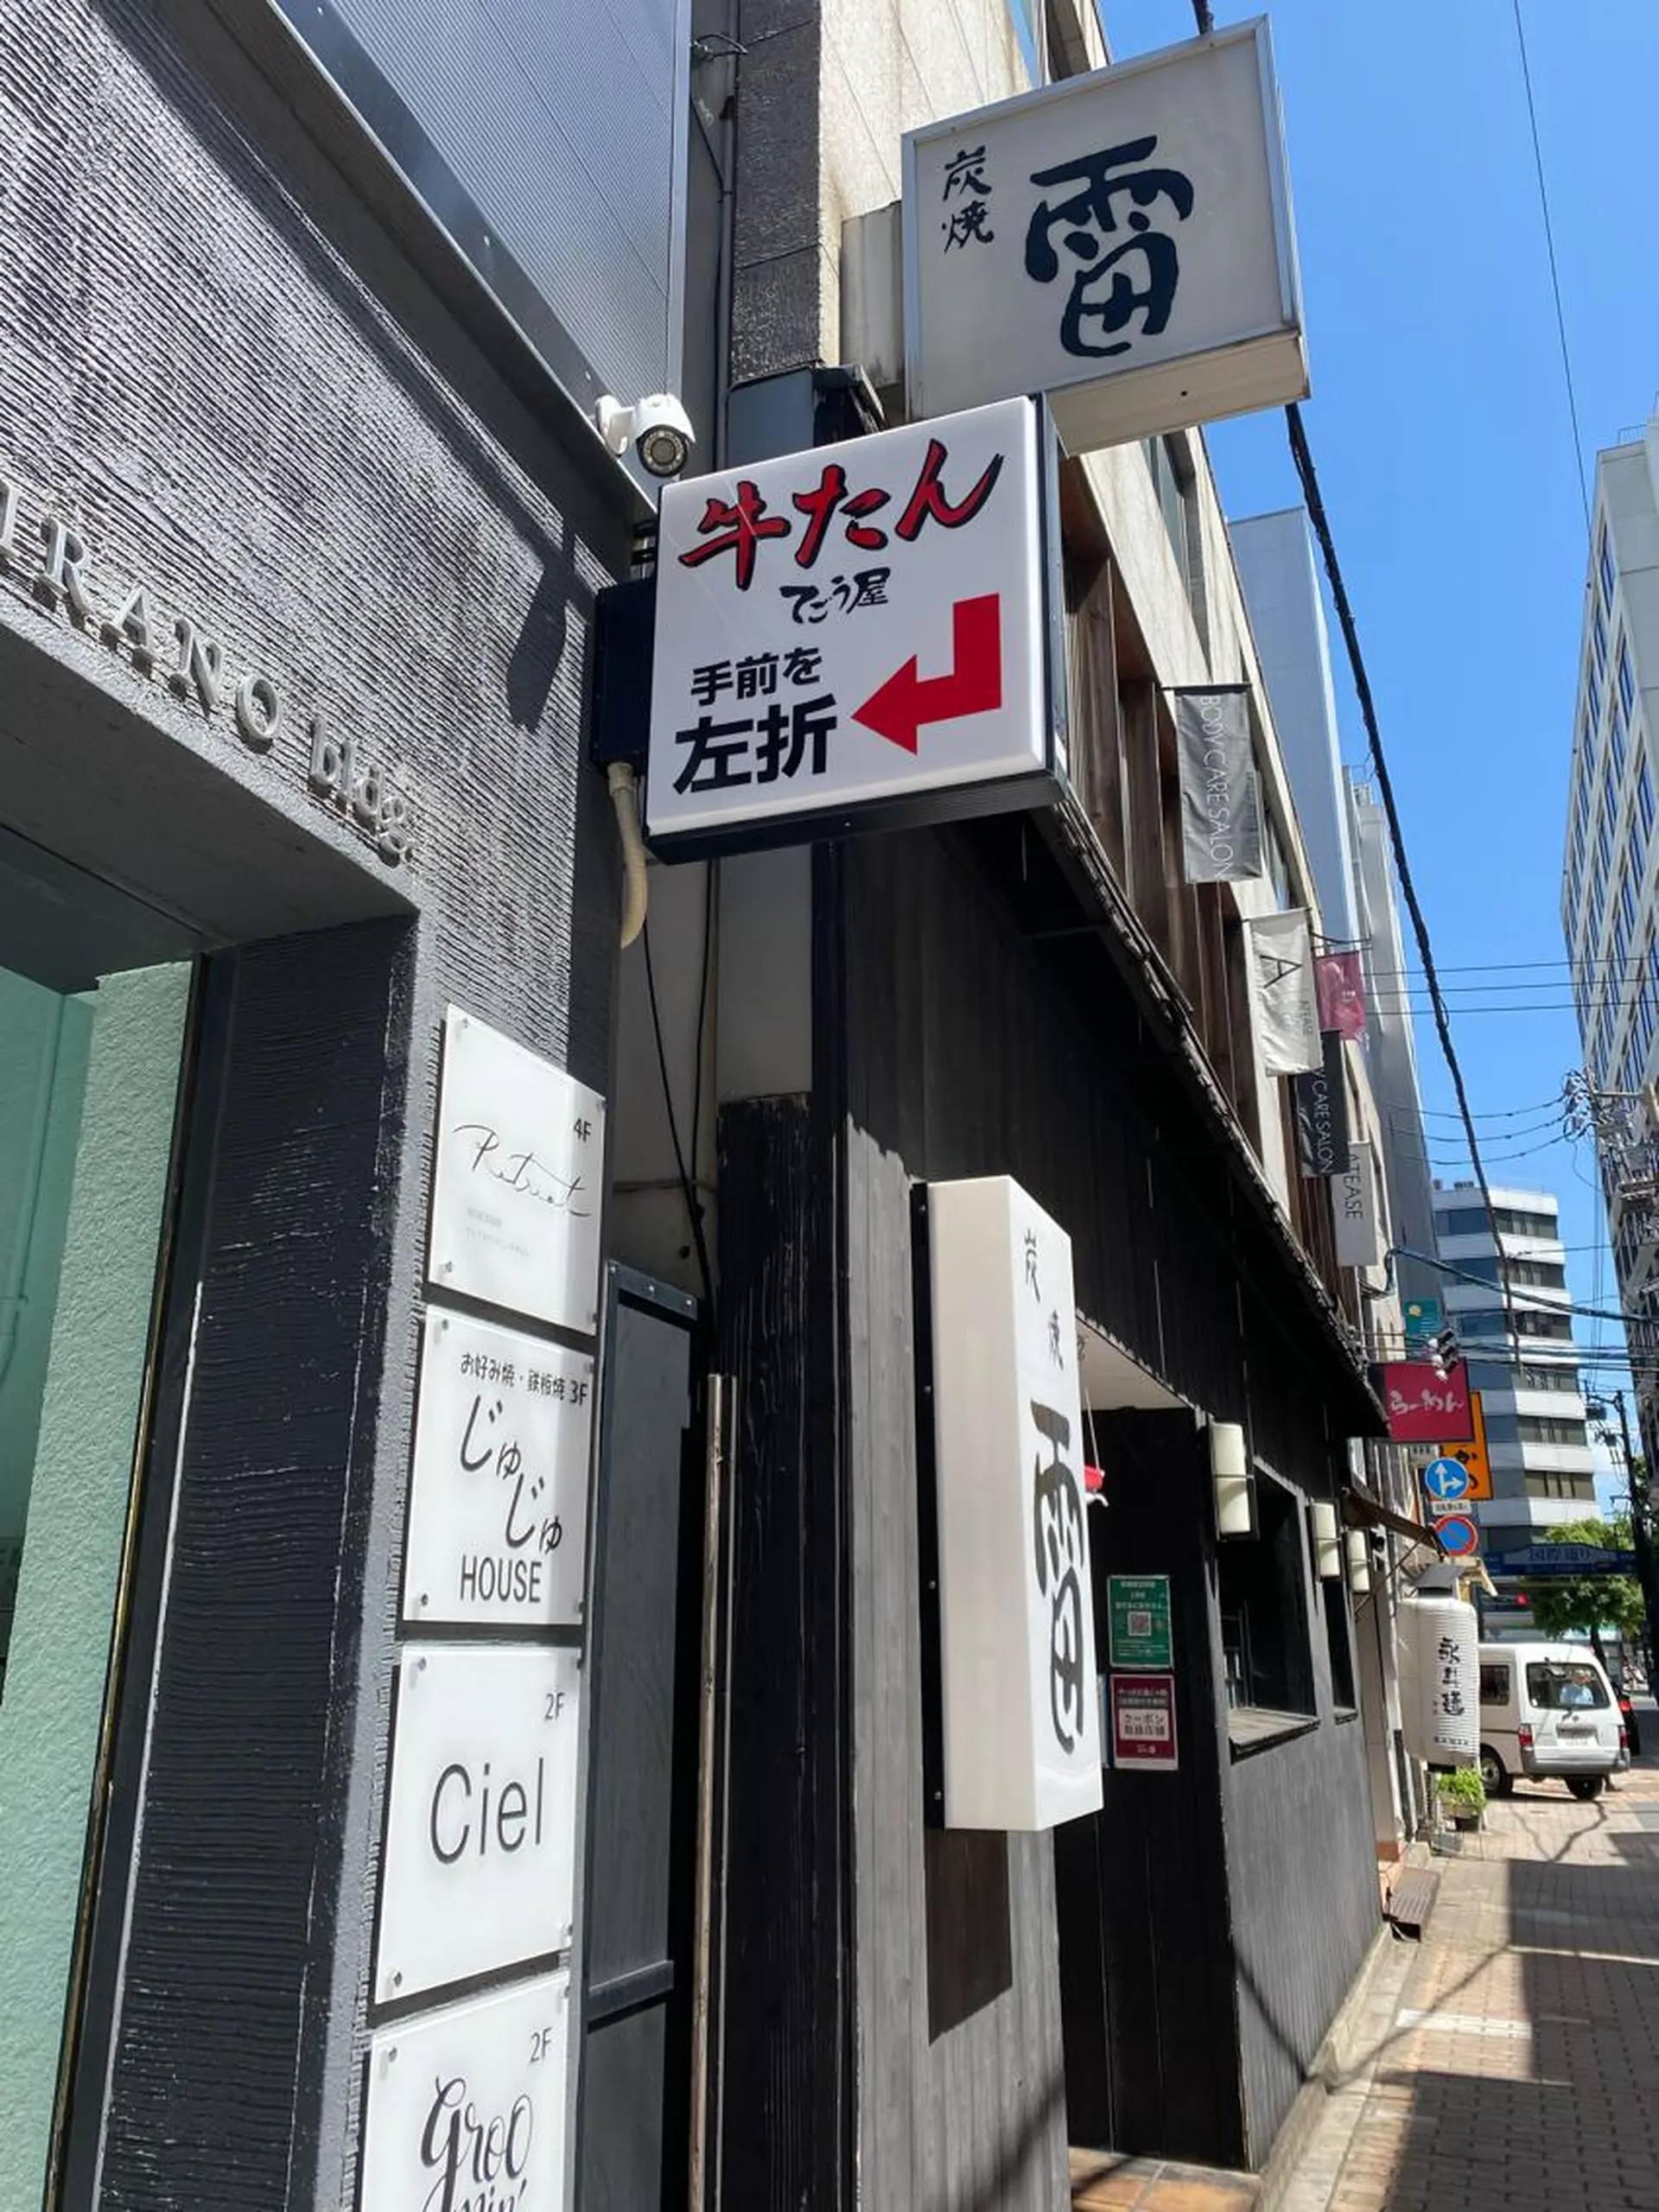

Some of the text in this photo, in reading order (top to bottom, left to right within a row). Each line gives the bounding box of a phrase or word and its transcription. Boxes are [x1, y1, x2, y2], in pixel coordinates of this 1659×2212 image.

[942, 144, 994, 253] 炭焼
[1025, 135, 1194, 358] 雷
[678, 438, 1005, 590] 牛たん
[691, 646, 823, 706] 手前を
[673, 693, 837, 795] 左折
[1199, 696, 1235, 880] BODY CARE SALON
[1312, 1081, 1331, 1119] CARE
[573, 1117, 592, 1143] 4F
[1315, 1119, 1334, 1173] SALON
[569, 1380, 588, 1407] 3F
[1388, 1388, 1465, 1416] らーめん
[460, 1554, 543, 1604] HOUSE
[544, 1691, 566, 1722] 2F
[430, 1757, 545, 1866] Ciel
[529, 2026, 552, 2064] 2F
